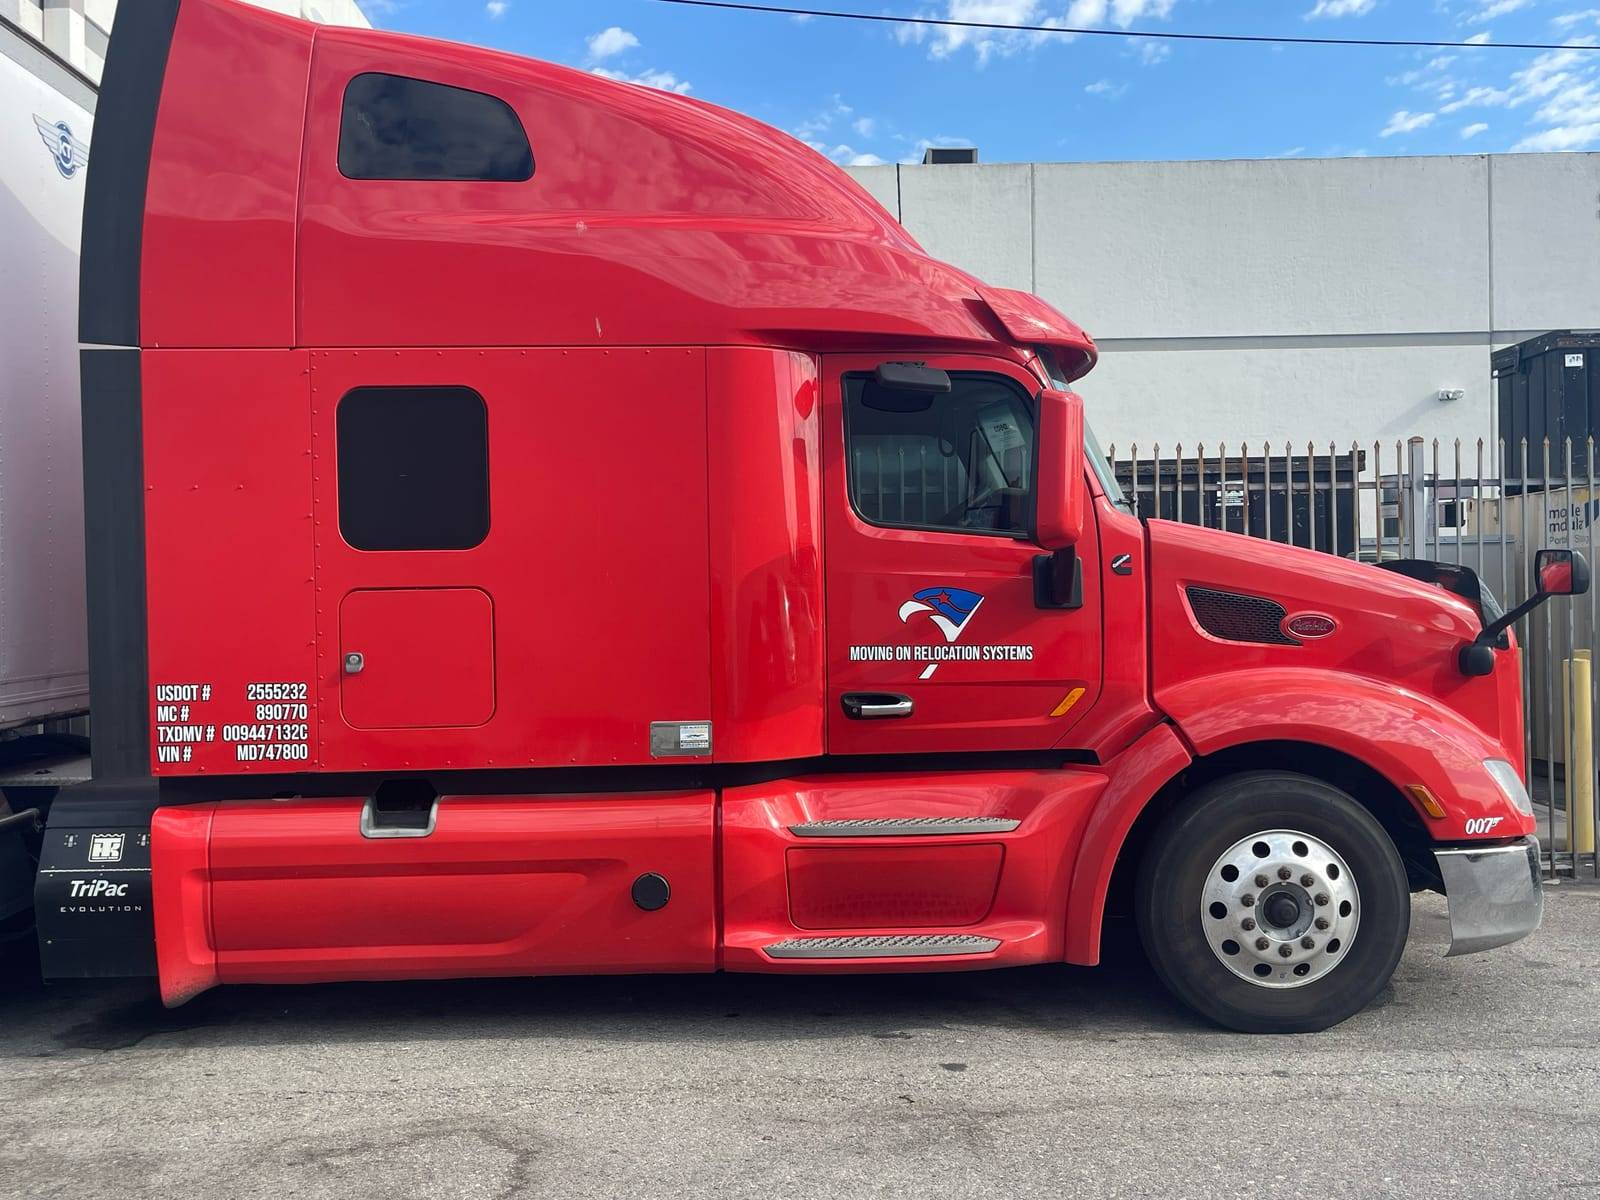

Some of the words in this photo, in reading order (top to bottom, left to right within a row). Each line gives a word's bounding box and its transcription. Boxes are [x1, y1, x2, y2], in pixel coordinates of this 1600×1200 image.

[850, 645, 893, 661] MOVING
[895, 645, 911, 661] ON
[914, 645, 980, 661] RELOCATION
[982, 645, 1033, 661] SYSTEMS
[156, 685, 199, 701] USDOT
[202, 684, 211, 701] #
[247, 683, 307, 700] 2555232
[156, 705, 178, 722] MC
[180, 705, 190, 722] #
[256, 703, 308, 720] 890770
[157, 725, 203, 742] TXDMV
[206, 725, 215, 742] #
[223, 724, 308, 742] 009447132C
[158, 746, 180, 762] VIN
[183, 745, 192, 762] #
[237, 744, 308, 761] MD747800
[1465, 816, 1493, 835] 007
[70, 879, 129, 897] TriPac
[60, 905, 142, 913] EVOLUTION
